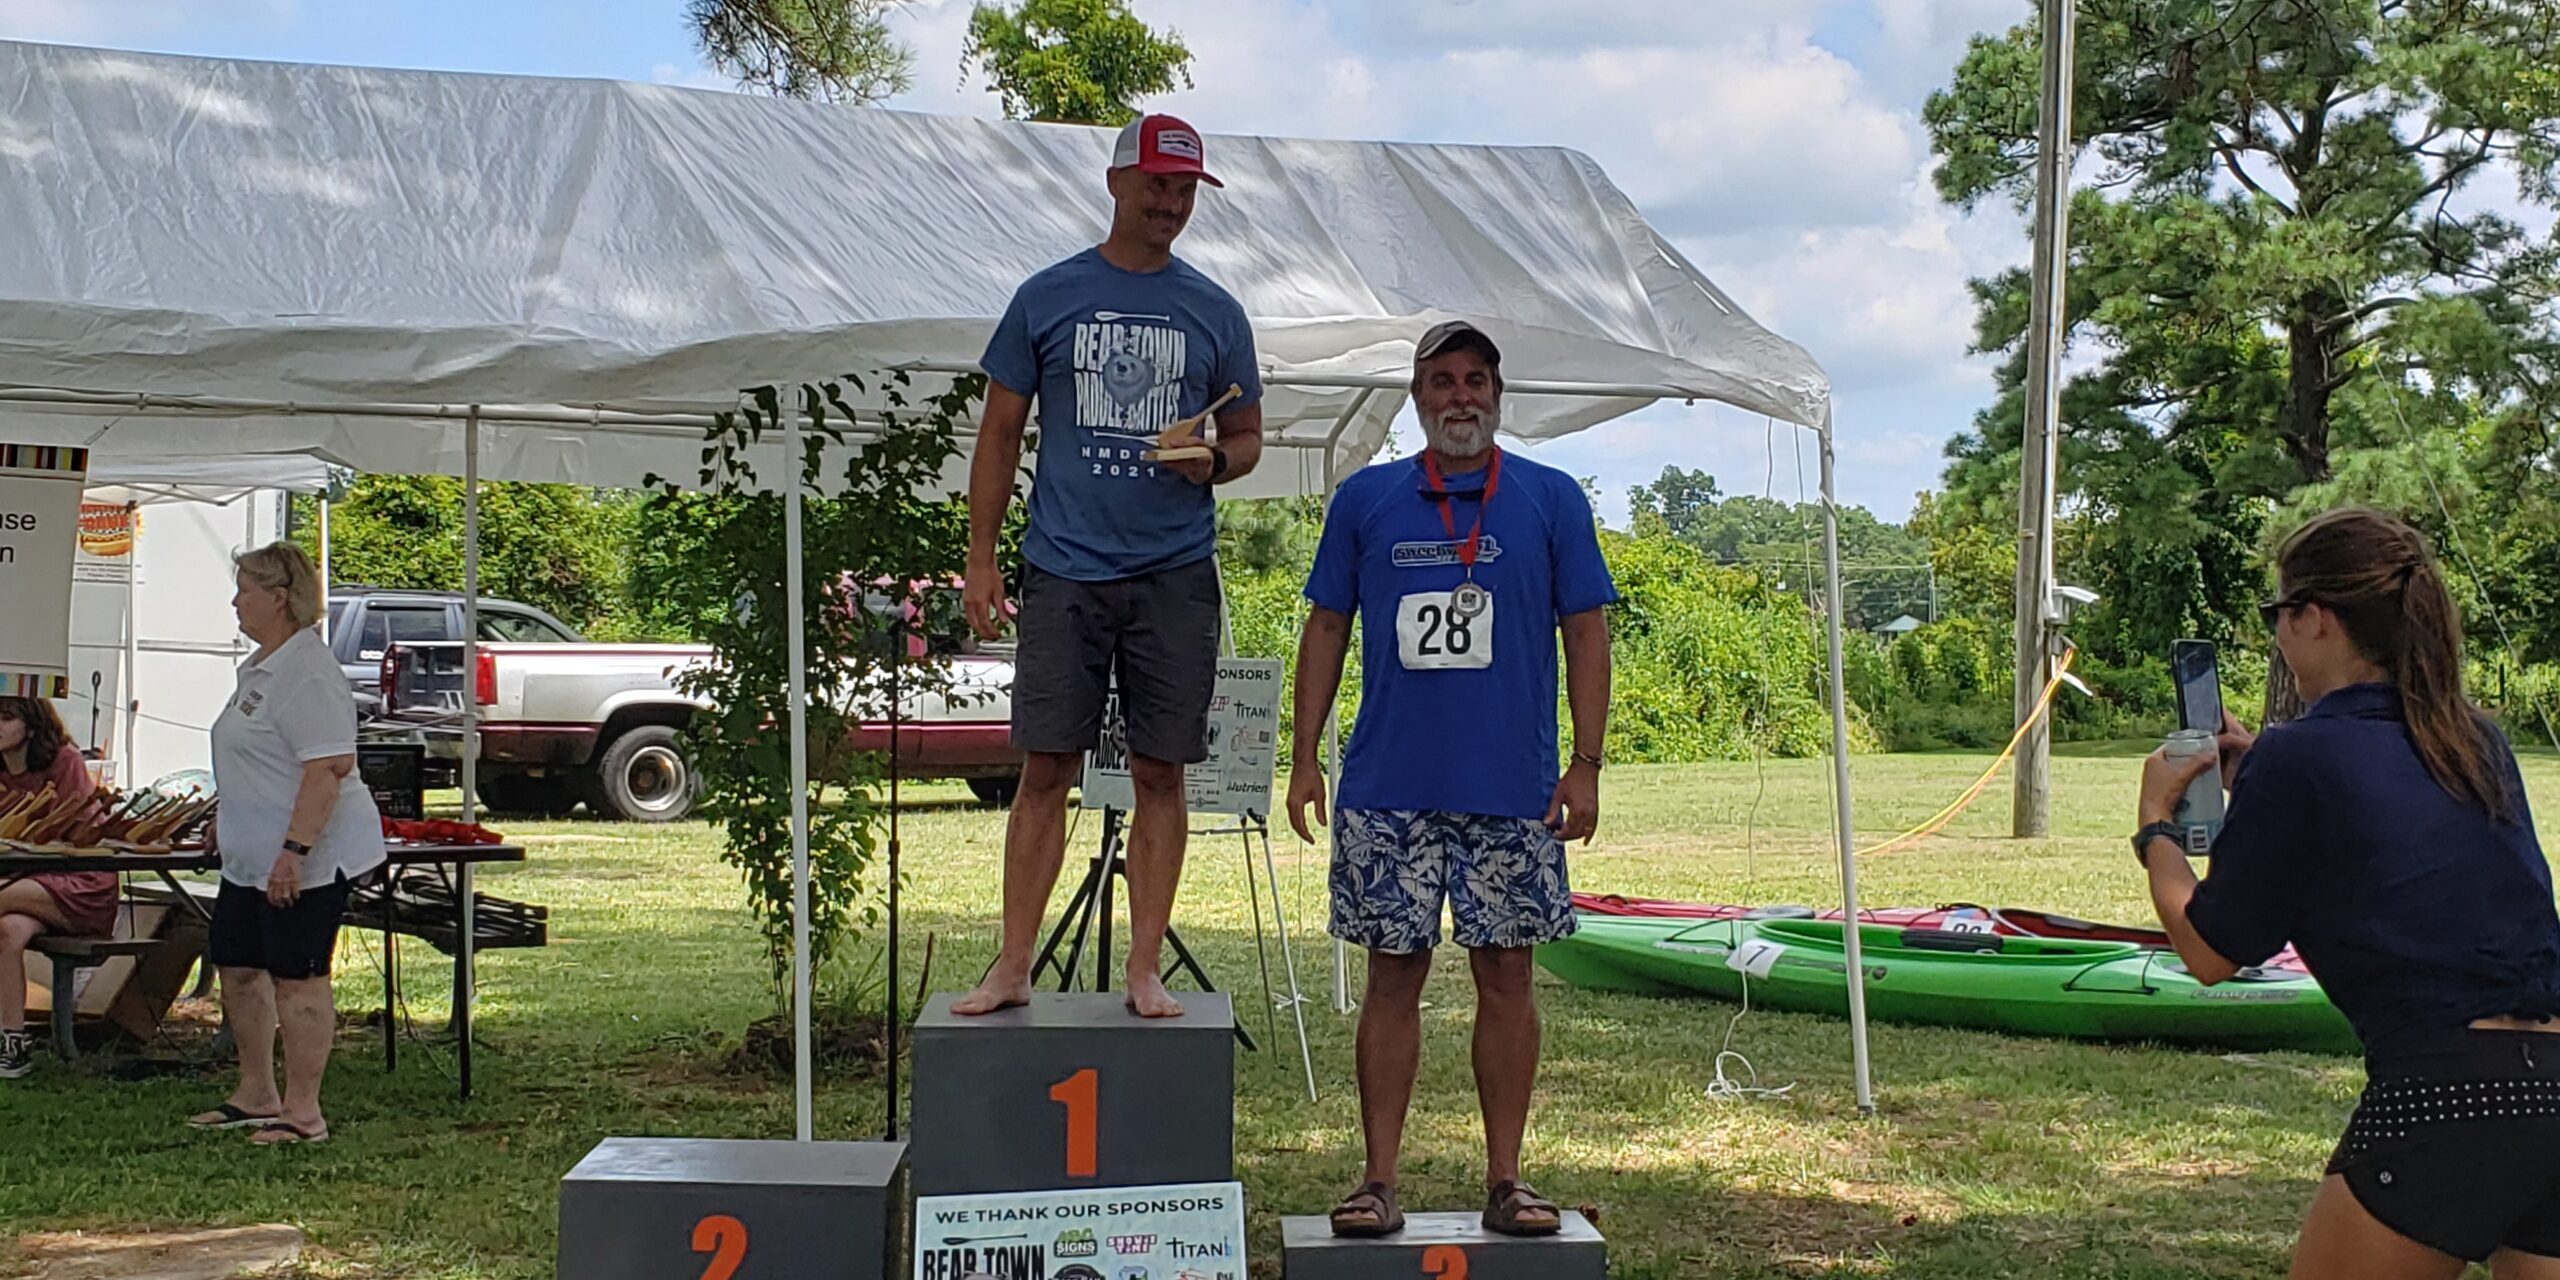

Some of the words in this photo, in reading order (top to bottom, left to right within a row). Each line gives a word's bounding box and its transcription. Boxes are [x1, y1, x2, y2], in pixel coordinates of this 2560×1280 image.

[1129, 325, 1186, 385] TOWN
[1092, 463, 1155, 478] 2021
[1417, 604, 1471, 656] 28
[1215, 668, 1271, 681] ONSORS
[1227, 781, 1268, 794] Nutrien
[1050, 1068, 1098, 1178] 1
[936, 1211, 969, 1224] WE
[975, 1206, 1049, 1222] THANK
[1055, 1203, 1101, 1219] OUR
[1107, 1198, 1224, 1216] SPONSORS
[690, 1214, 748, 1280] 2
[1056, 1241, 1096, 1254] SIGNS
[1165, 1236, 1223, 1259] TITAN
[983, 1244, 1045, 1280] TOWN
